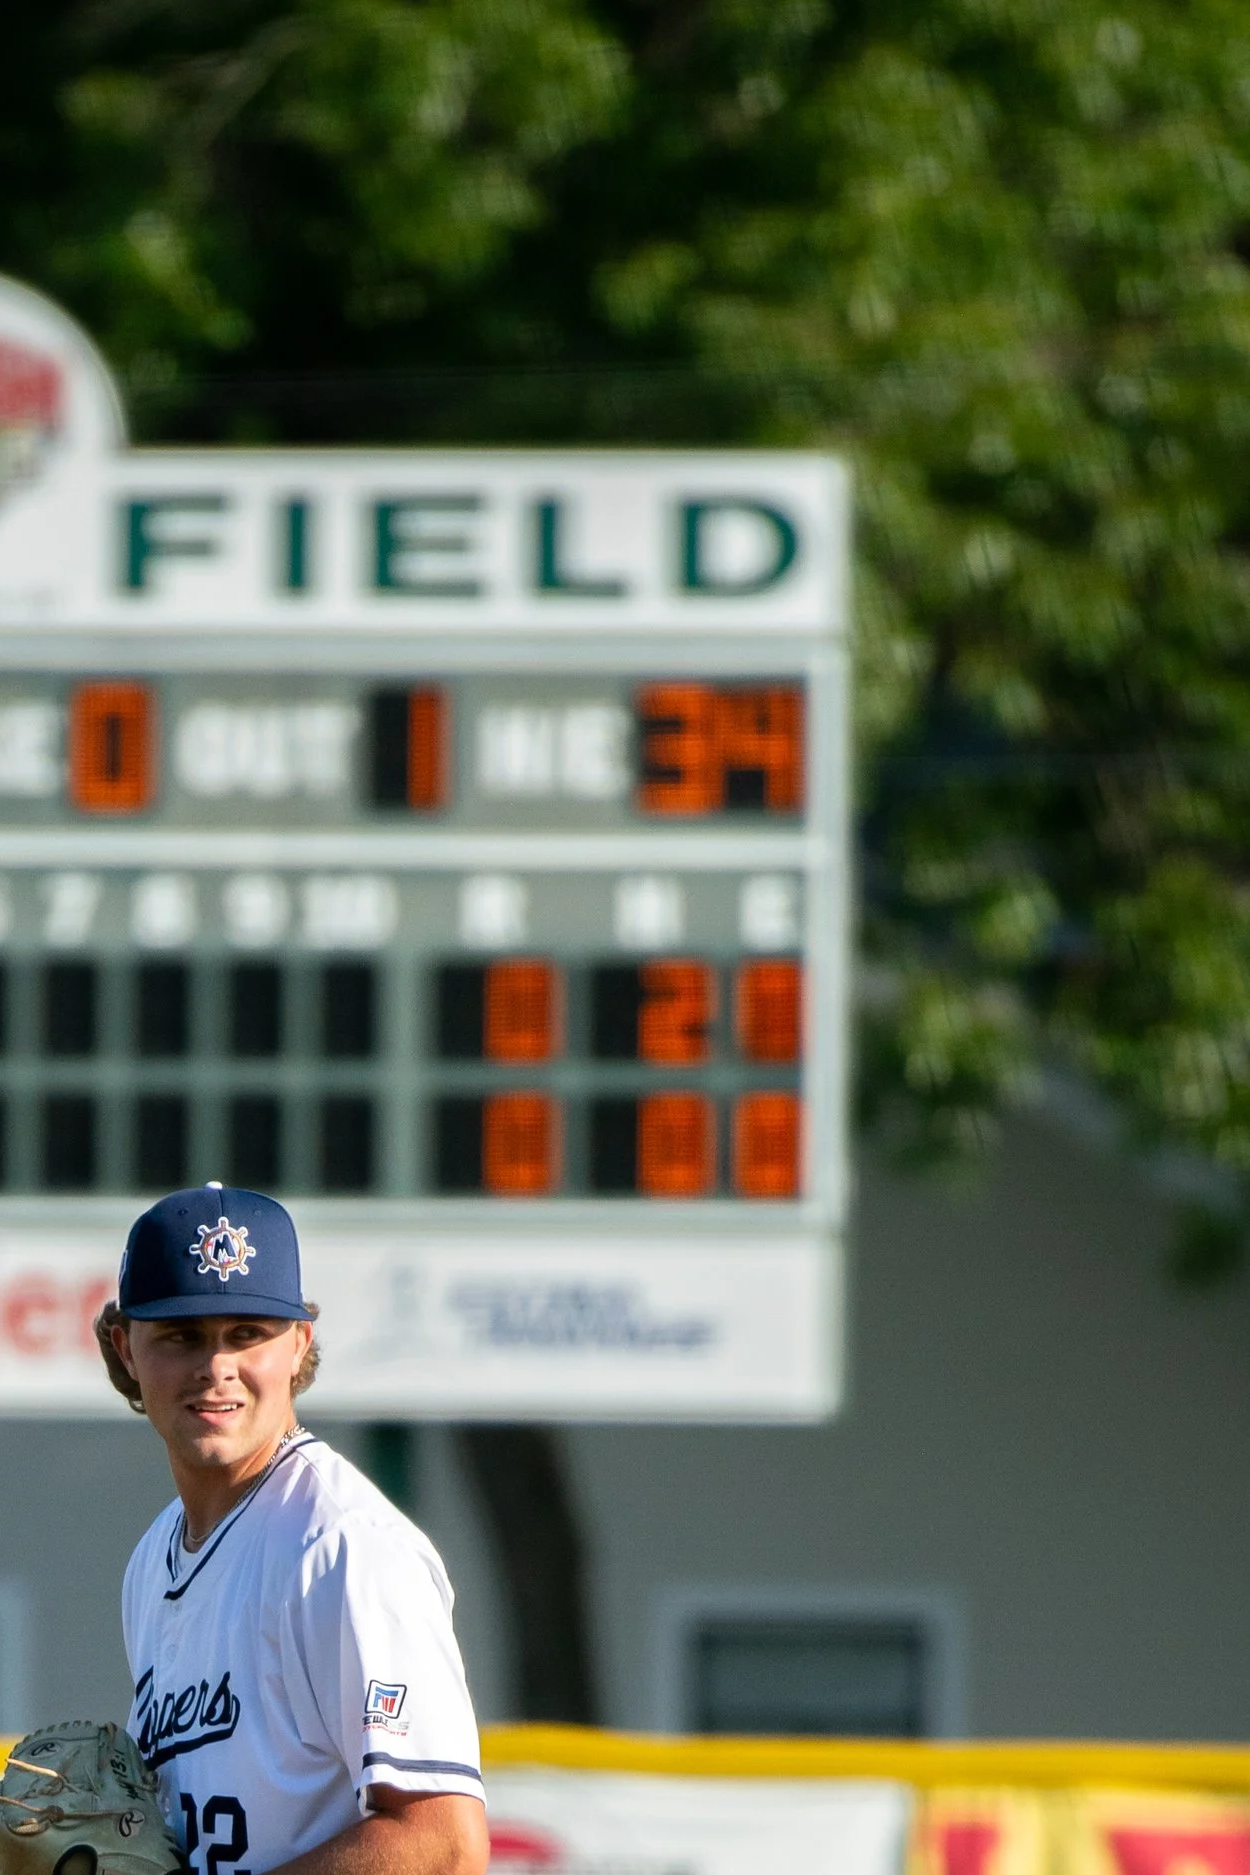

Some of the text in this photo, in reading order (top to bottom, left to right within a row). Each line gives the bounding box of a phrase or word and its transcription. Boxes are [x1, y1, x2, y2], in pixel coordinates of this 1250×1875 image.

[117, 491, 800, 597] FIELD
[70, 680, 154, 814] 0
[178, 682, 452, 816] OUT 1
[635, 682, 806, 818] 34
[42, 872, 102, 949] 7
[130, 872, 198, 950] 8
[222, 872, 290, 950] 9
[298, 872, 397, 952] 10
[638, 958, 718, 1067] 2
